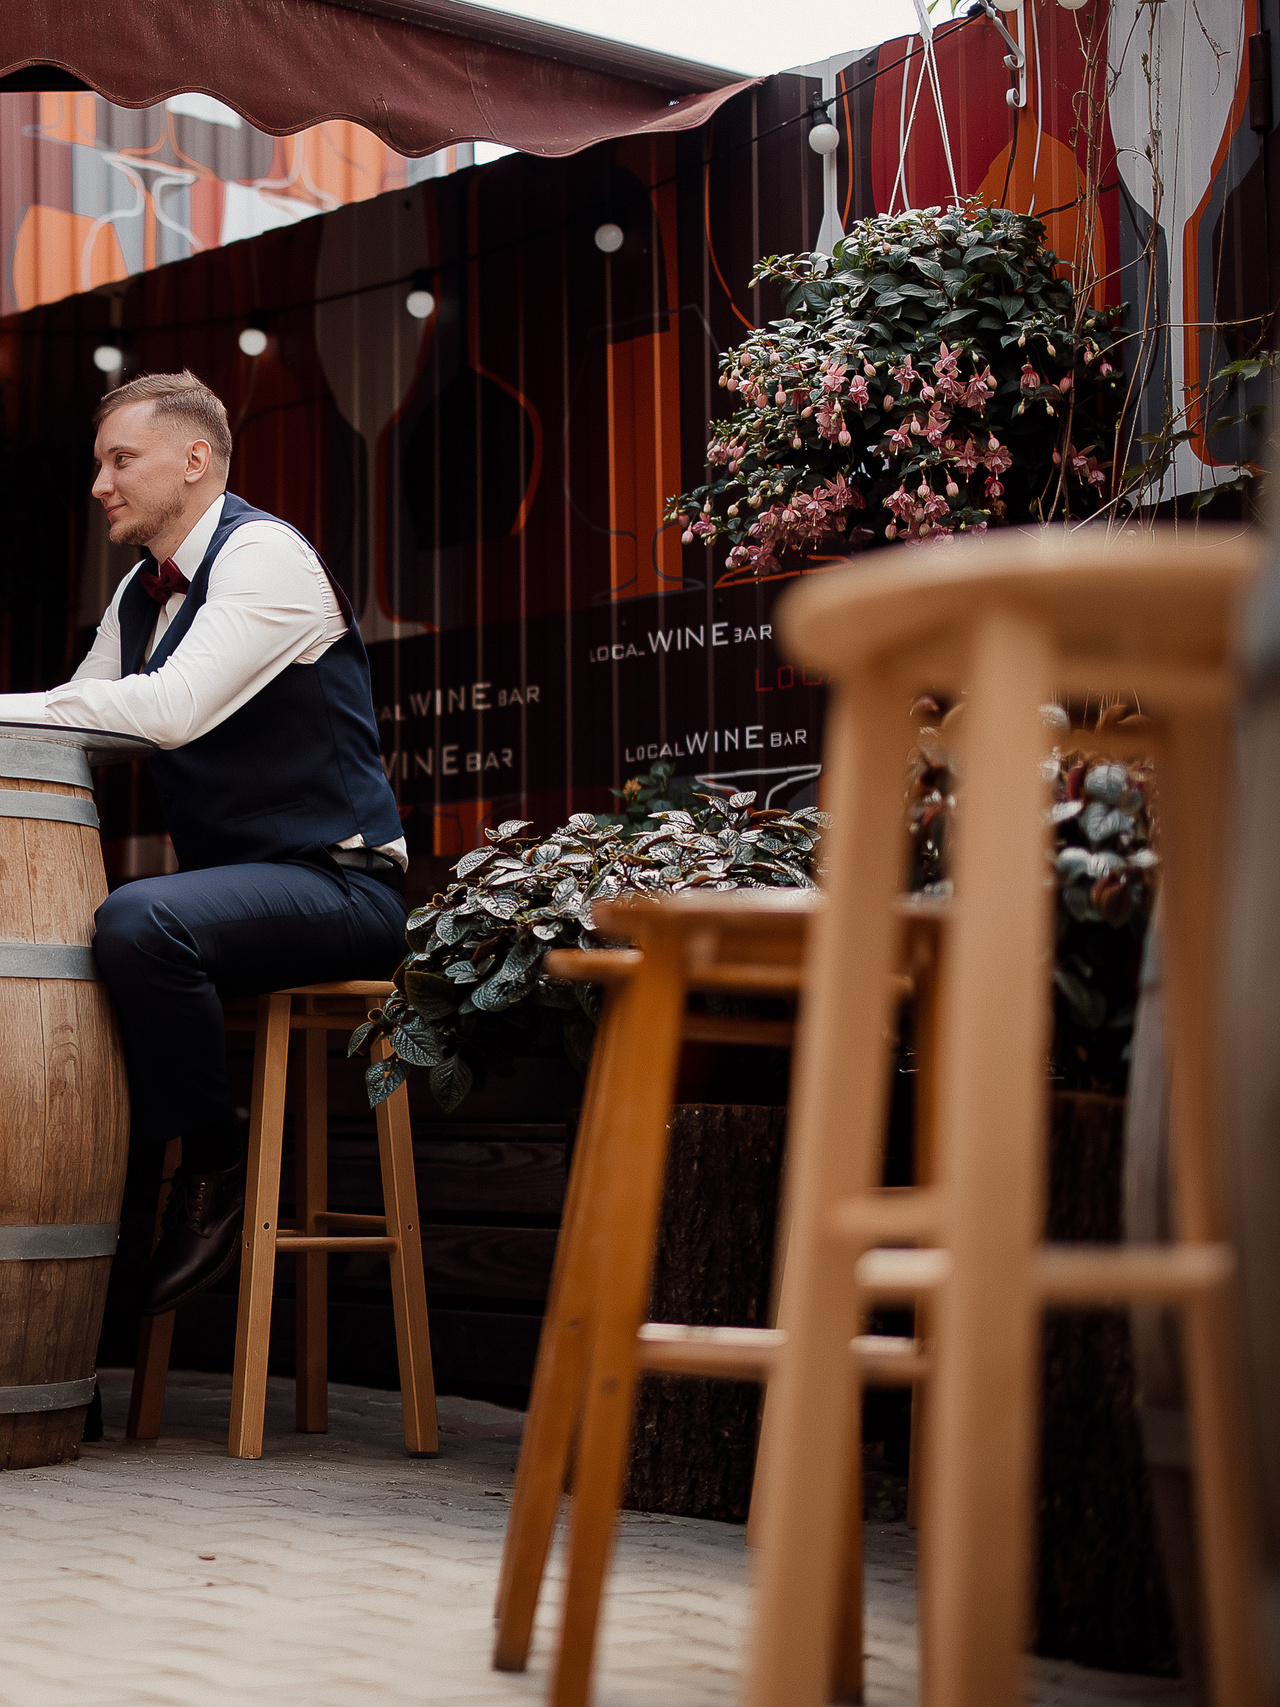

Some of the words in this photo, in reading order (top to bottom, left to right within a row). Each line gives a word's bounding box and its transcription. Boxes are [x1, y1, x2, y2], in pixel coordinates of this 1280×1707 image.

[647, 621, 729, 653] WINE
[733, 624, 773, 643] BAR
[754, 663, 831, 693] LOC
[408, 682, 493, 717] WINE
[497, 685, 541, 708] BAR
[624, 743, 685, 763] LOCAL
[685, 725, 764, 755] WINE
[770, 728, 808, 748] BAR
